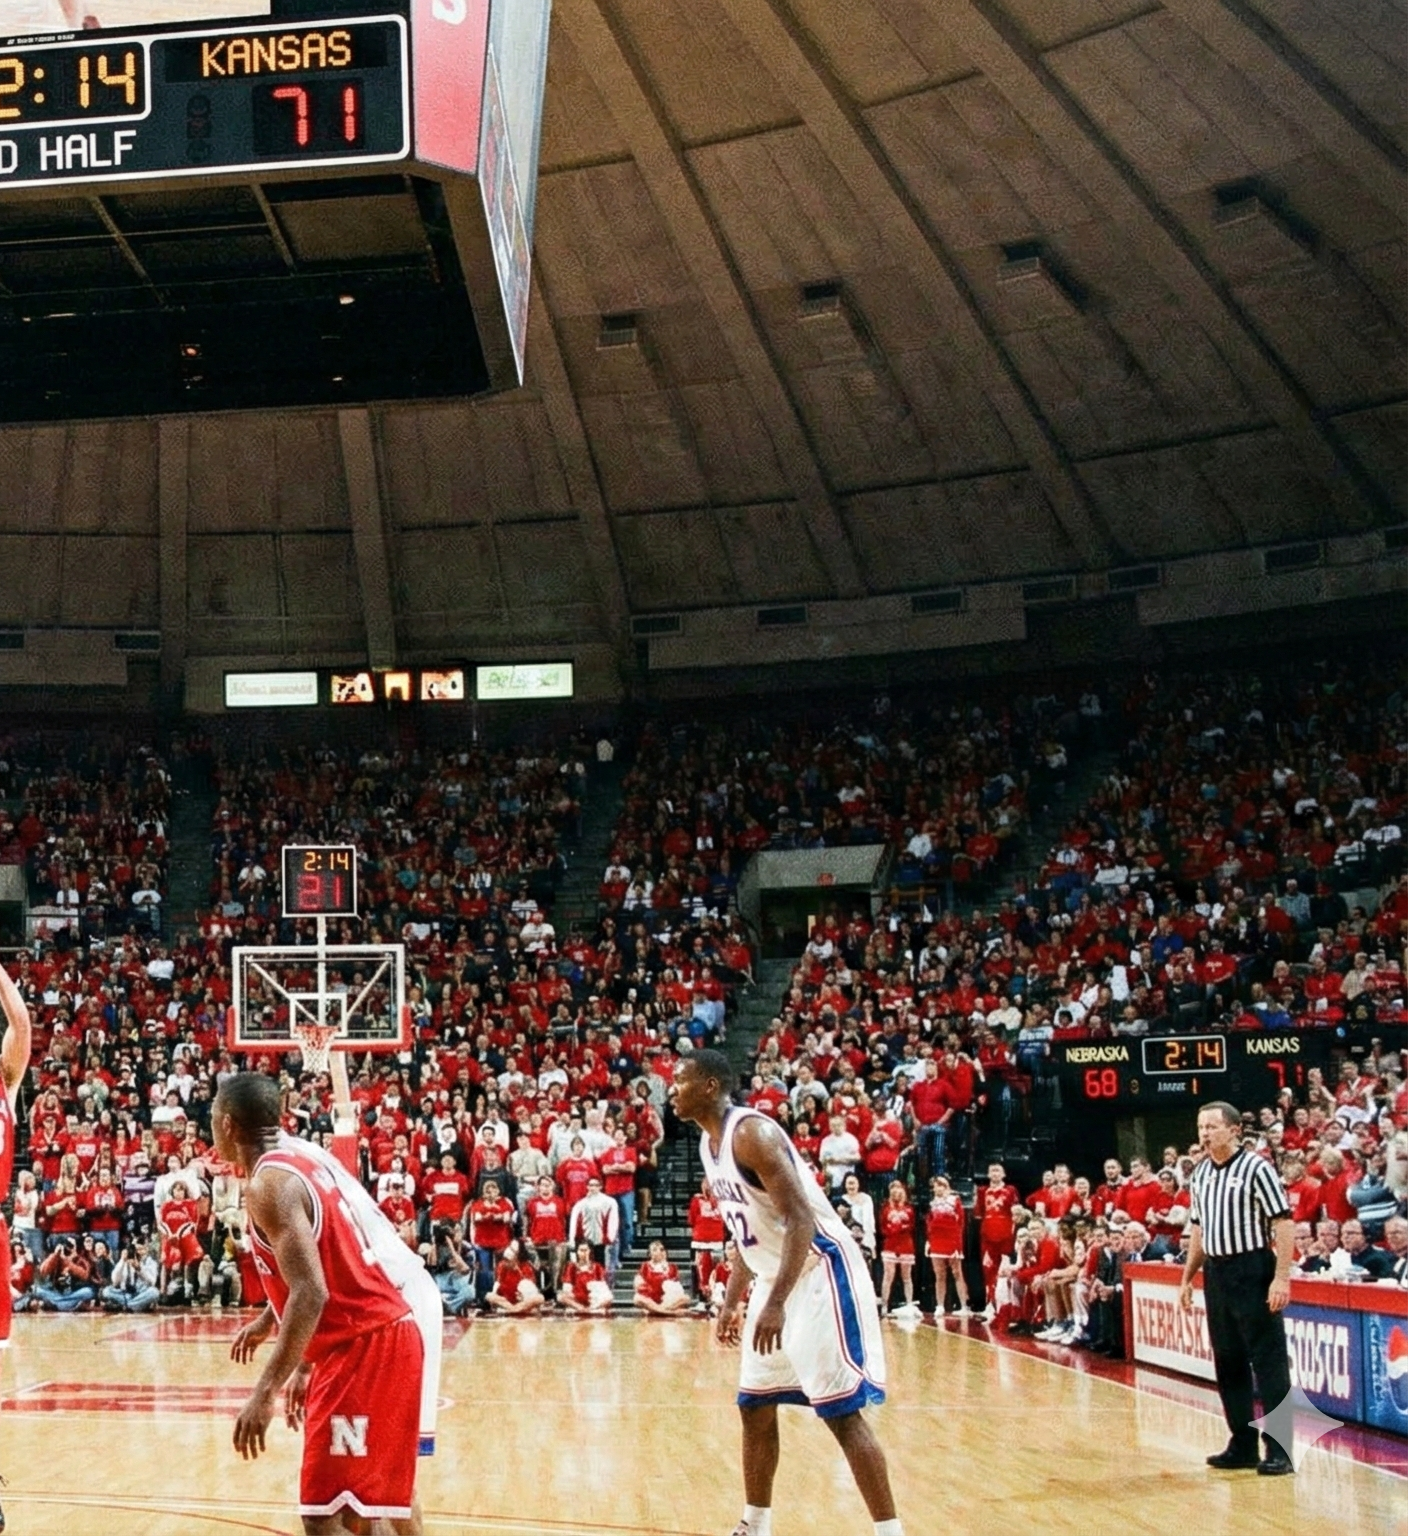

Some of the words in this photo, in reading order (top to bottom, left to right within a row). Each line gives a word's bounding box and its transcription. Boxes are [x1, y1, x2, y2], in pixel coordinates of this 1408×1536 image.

[202, 31, 352, 77] KANSAS
[273, 86, 356, 146] 71
[40, 130, 137, 172] HALF
[303, 852, 349, 872] 2:14
[1066, 1047, 1129, 1063] NEBRASKA
[1164, 1041, 1221, 1070] 2:14
[1246, 1037, 1301, 1054] KANSAS
[1084, 1069, 1118, 1097] 68
[1136, 1297, 1213, 1362] NEBRASK
[329, 1415, 369, 1457] N
